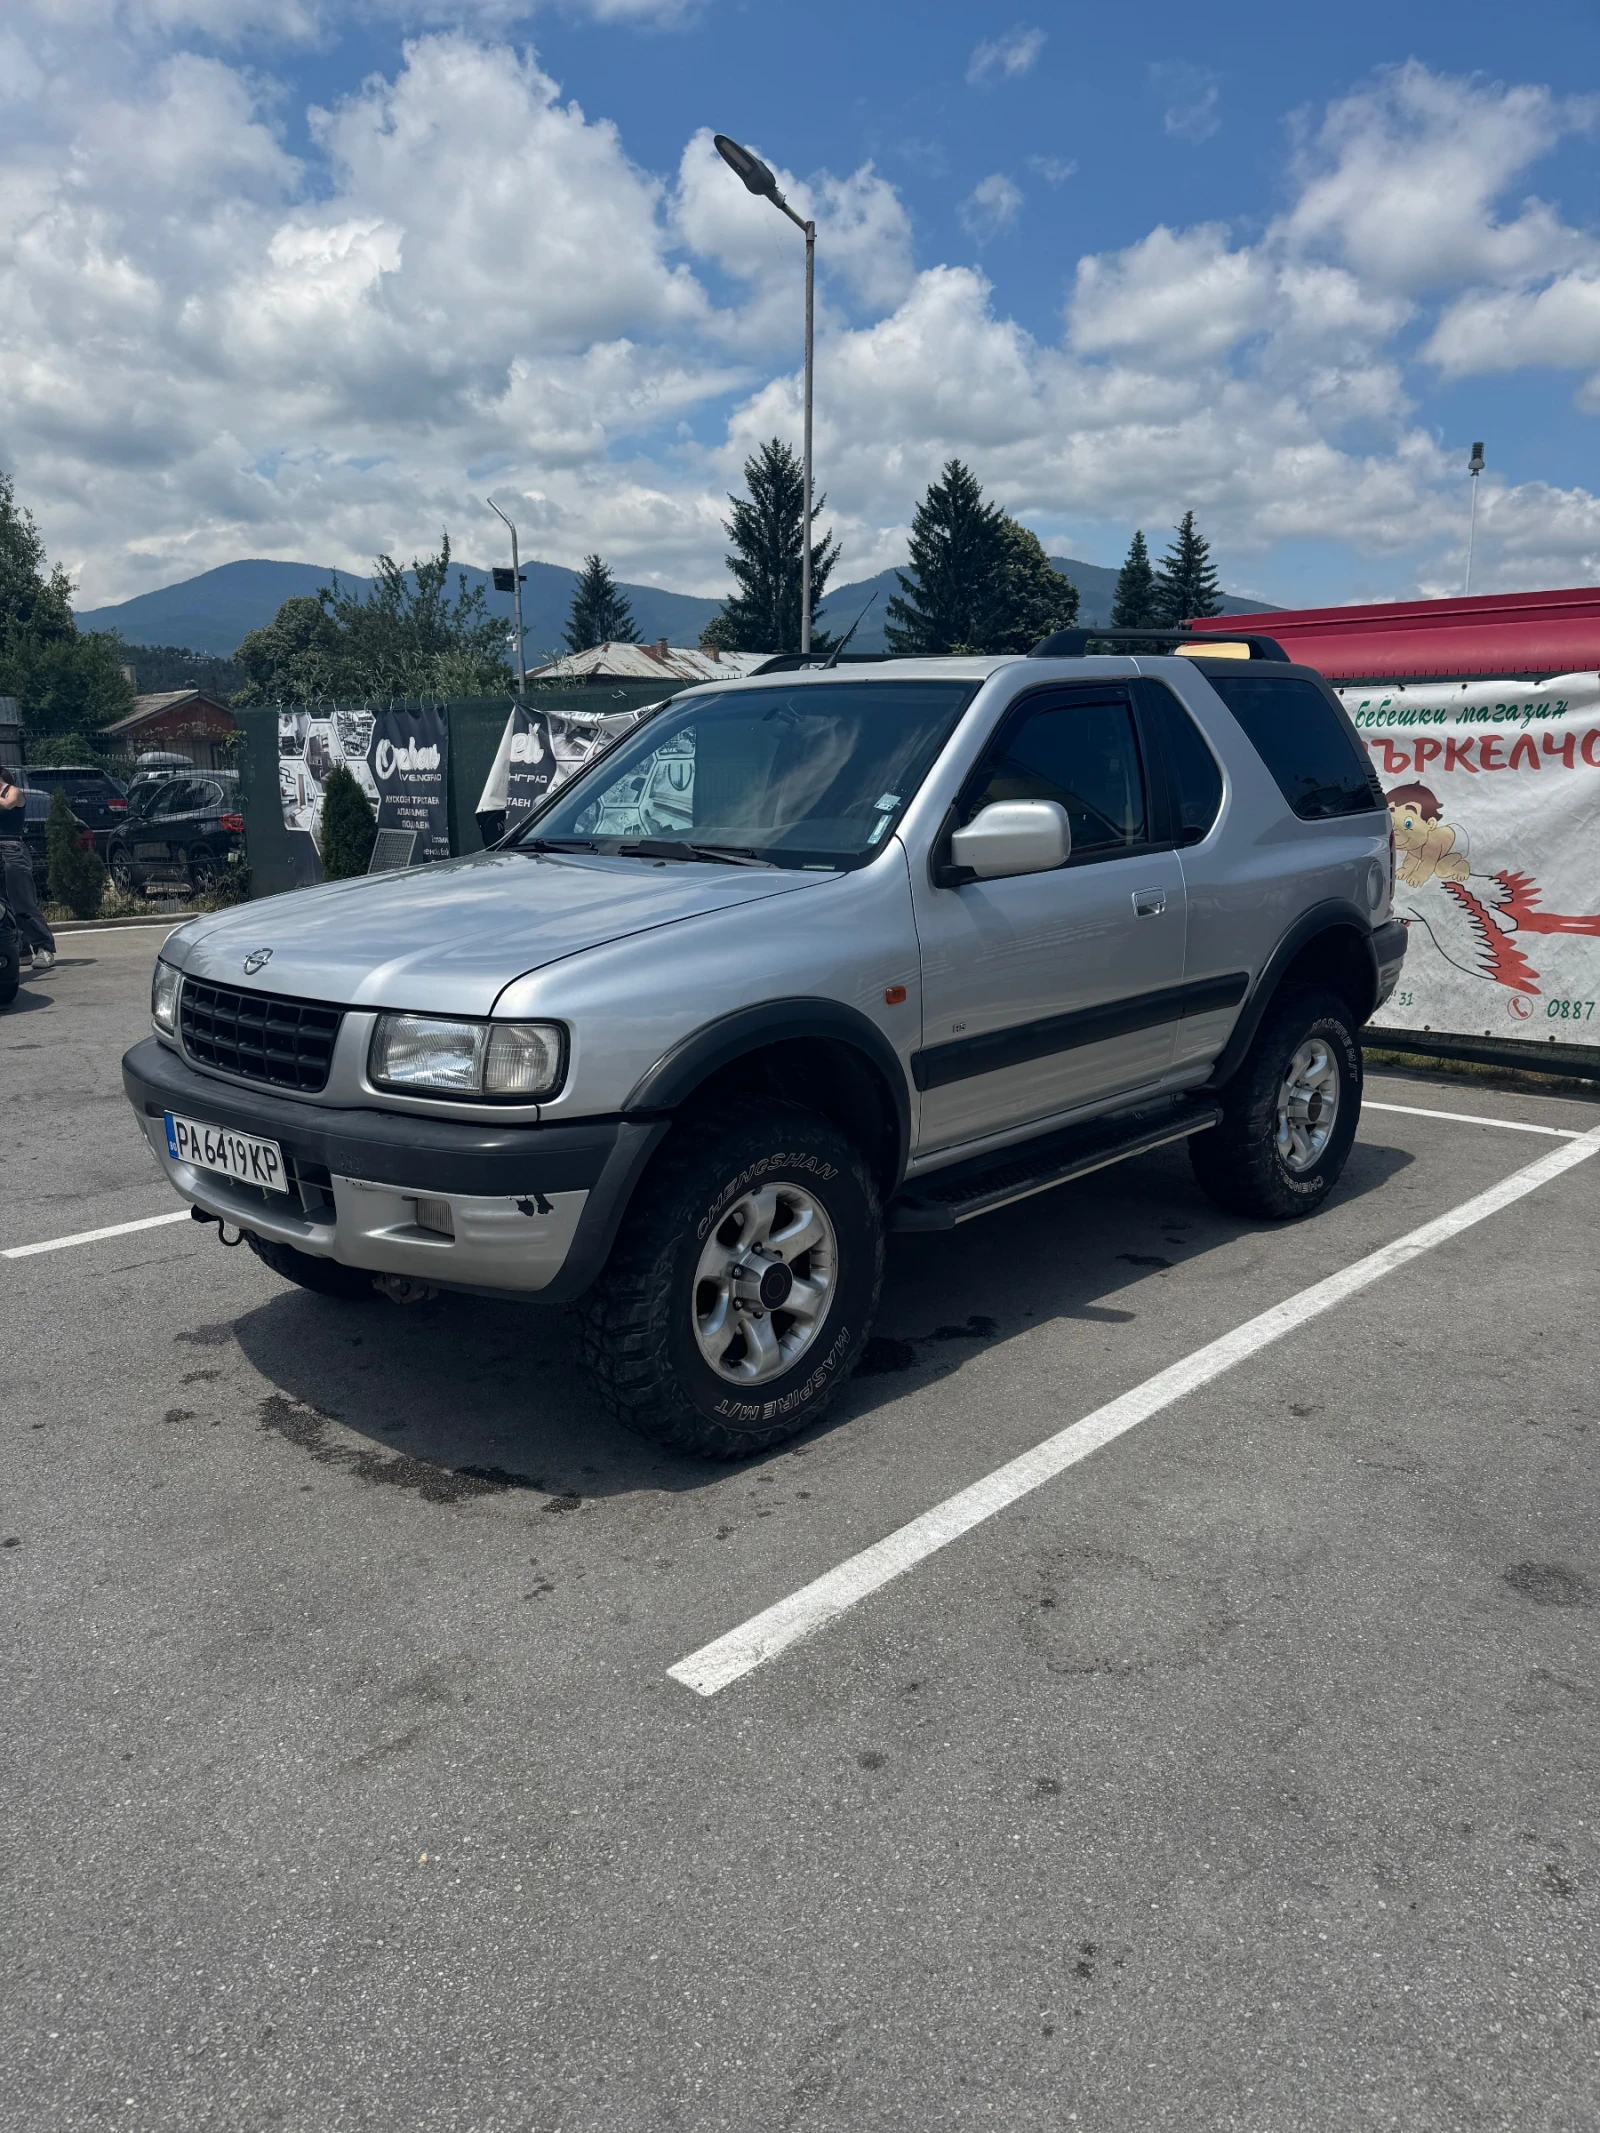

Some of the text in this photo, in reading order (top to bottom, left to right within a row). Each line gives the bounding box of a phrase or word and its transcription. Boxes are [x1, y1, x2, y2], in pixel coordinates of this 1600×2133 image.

[1355, 699, 1568, 729] бебешки магазин
[1362, 728, 1600, 774] ЪРКЕЛЧО
[1398, 992, 1413, 1006] 31
[1547, 999, 1596, 1020] 0887
[697, 1152, 838, 1241] CHENGSHAN
[713, 1326, 851, 1421] MASPIRE M/T
